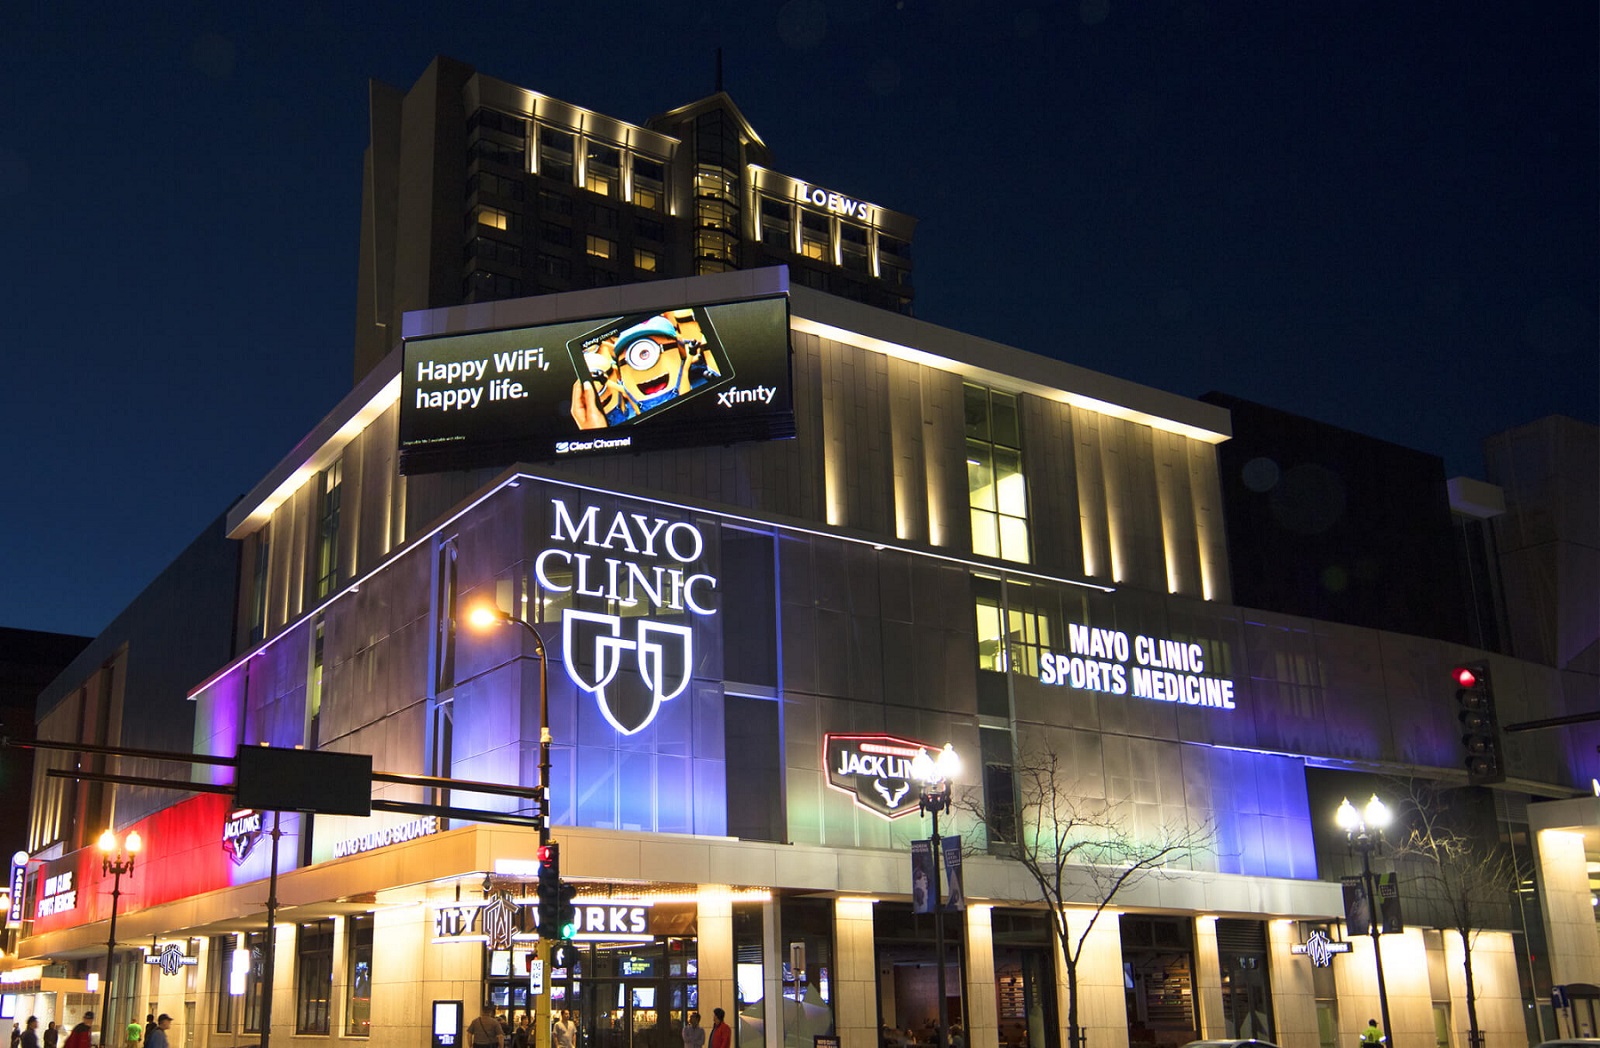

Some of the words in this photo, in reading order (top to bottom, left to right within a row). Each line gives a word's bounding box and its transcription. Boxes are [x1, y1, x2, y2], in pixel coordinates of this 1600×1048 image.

[803, 185, 868, 220] LOEWS
[417, 359, 488, 384] Happy
[493, 347, 550, 373] WiFi,
[416, 386, 483, 412] happy
[489, 378, 528, 401] life.
[717, 384, 777, 408] xfinity
[569, 441, 593, 452] Clear
[594, 437, 631, 449] Channel
[551, 499, 703, 563] MAYO
[535, 549, 717, 615] CLINIC
[1068, 622, 1129, 662] MAYO
[1134, 634, 1204, 674] CLINIC
[1040, 652, 1127, 695] SPORTS
[1132, 666, 1236, 709] MEDICINE
[838, 750, 887, 779] JACK
[333, 836, 361, 859] MAYO
[393, 815, 437, 844] SQUARE
[12, 867, 25, 920] PARKING
[433, 907, 478, 936] CITY
